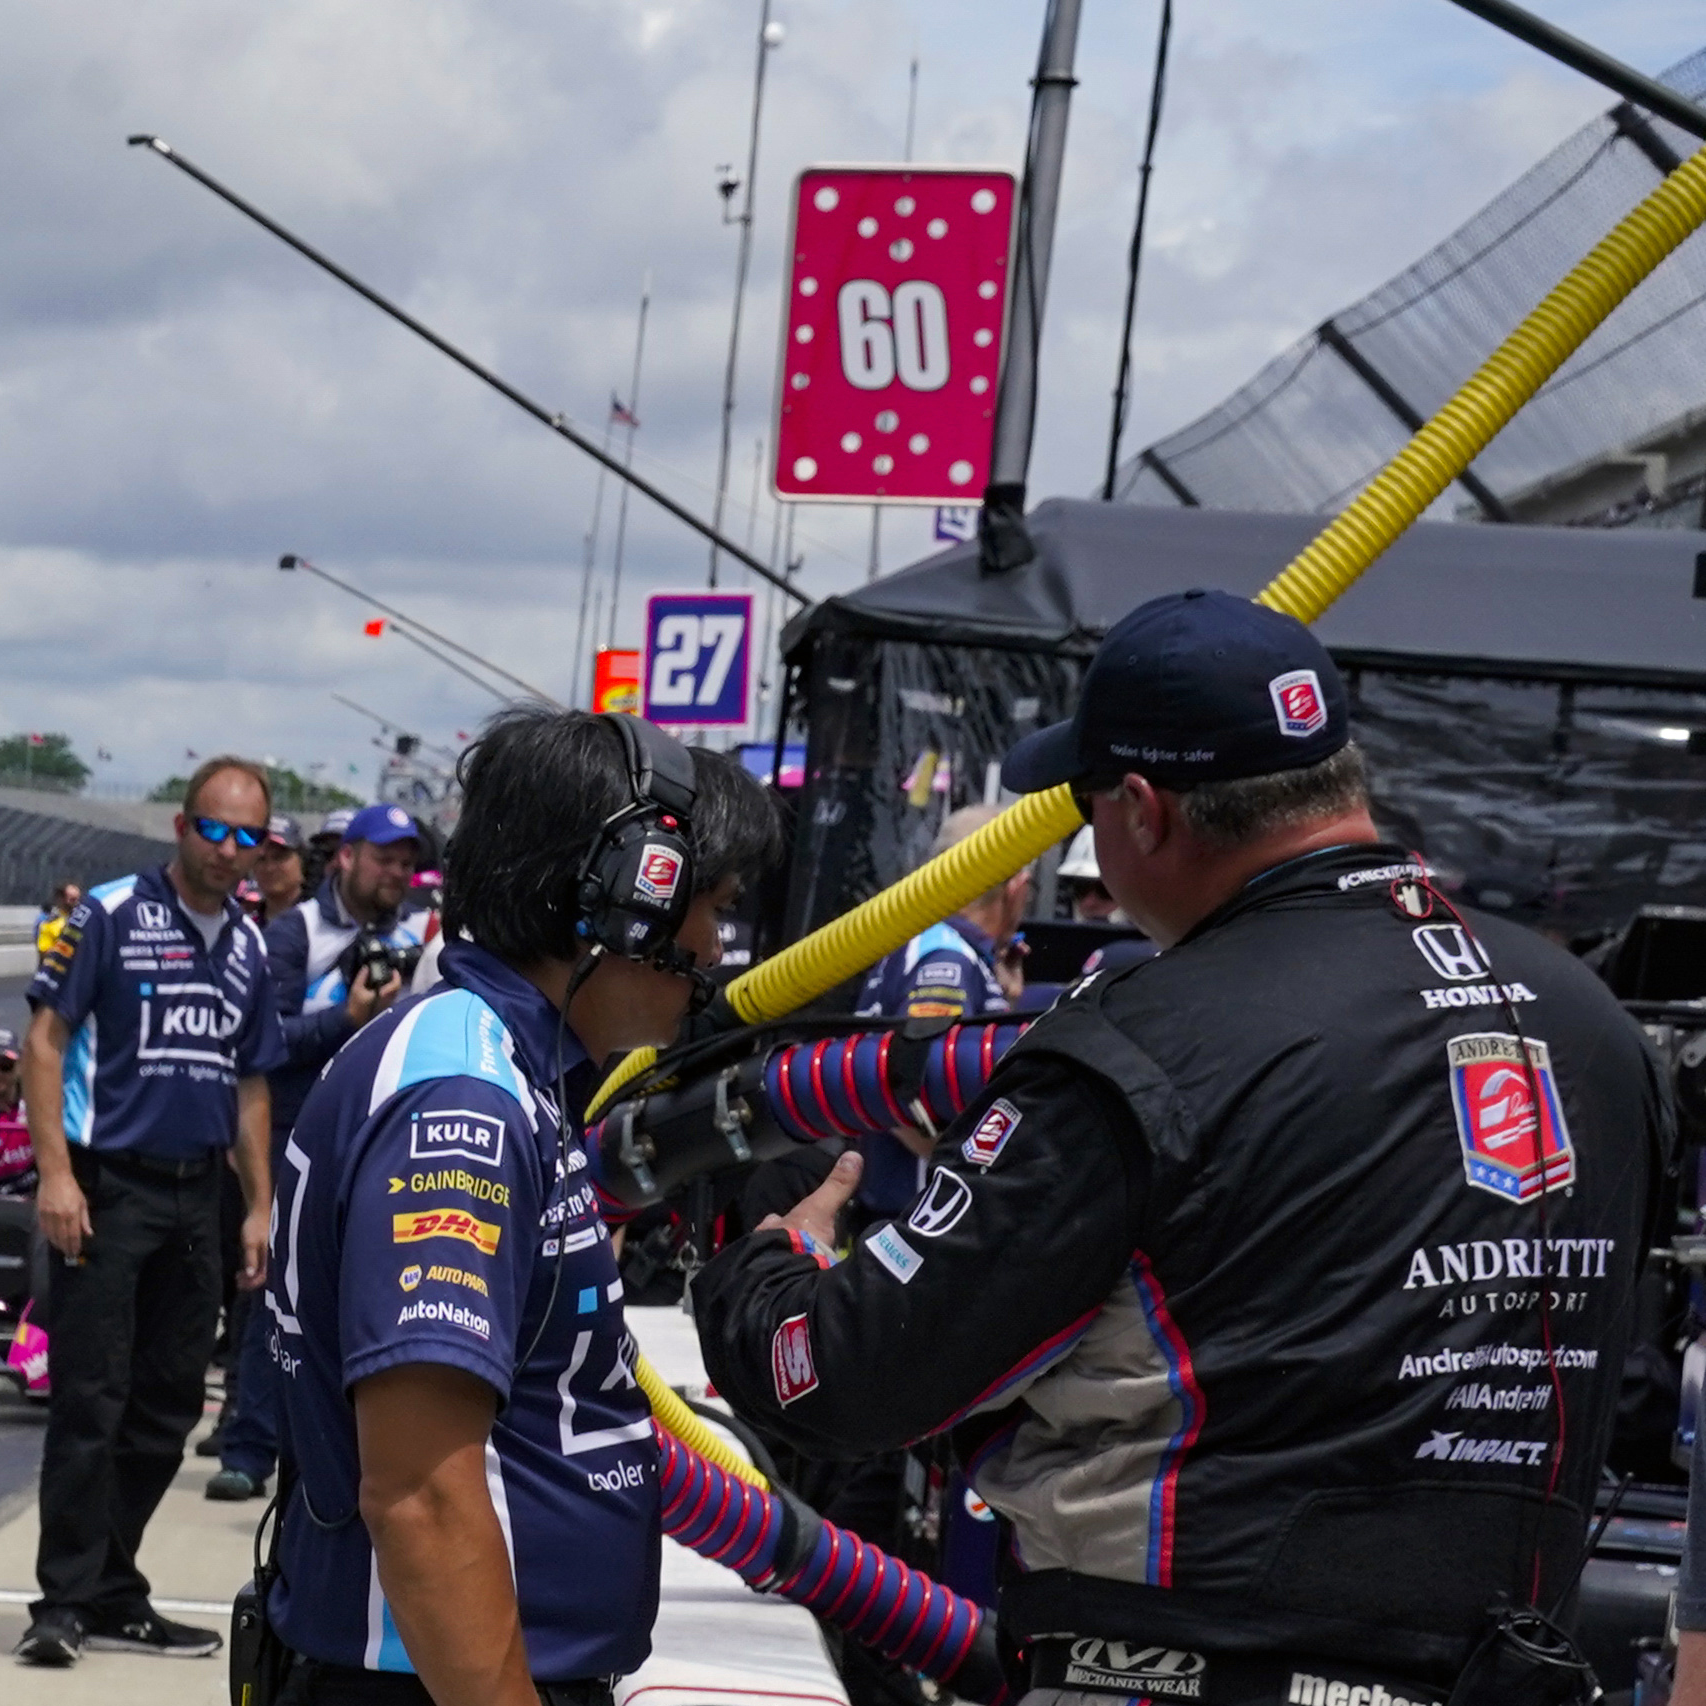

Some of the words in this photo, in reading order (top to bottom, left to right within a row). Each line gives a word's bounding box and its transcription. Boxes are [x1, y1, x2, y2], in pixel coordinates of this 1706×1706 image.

[837, 279, 949, 391] 60
[649, 614, 745, 706] 27
[1185, 750, 1216, 762] safer
[629, 922, 649, 939] 98
[427, 1123, 492, 1148] KULR
[411, 1170, 510, 1208] GAINBRIDGE
[413, 1214, 484, 1243] DHL
[427, 1265, 461, 1285] AUTO
[398, 1300, 490, 1338] AutoNation
[1065, 1663, 1146, 1690] MECHANIX
[1147, 1675, 1201, 1698] WEAR
